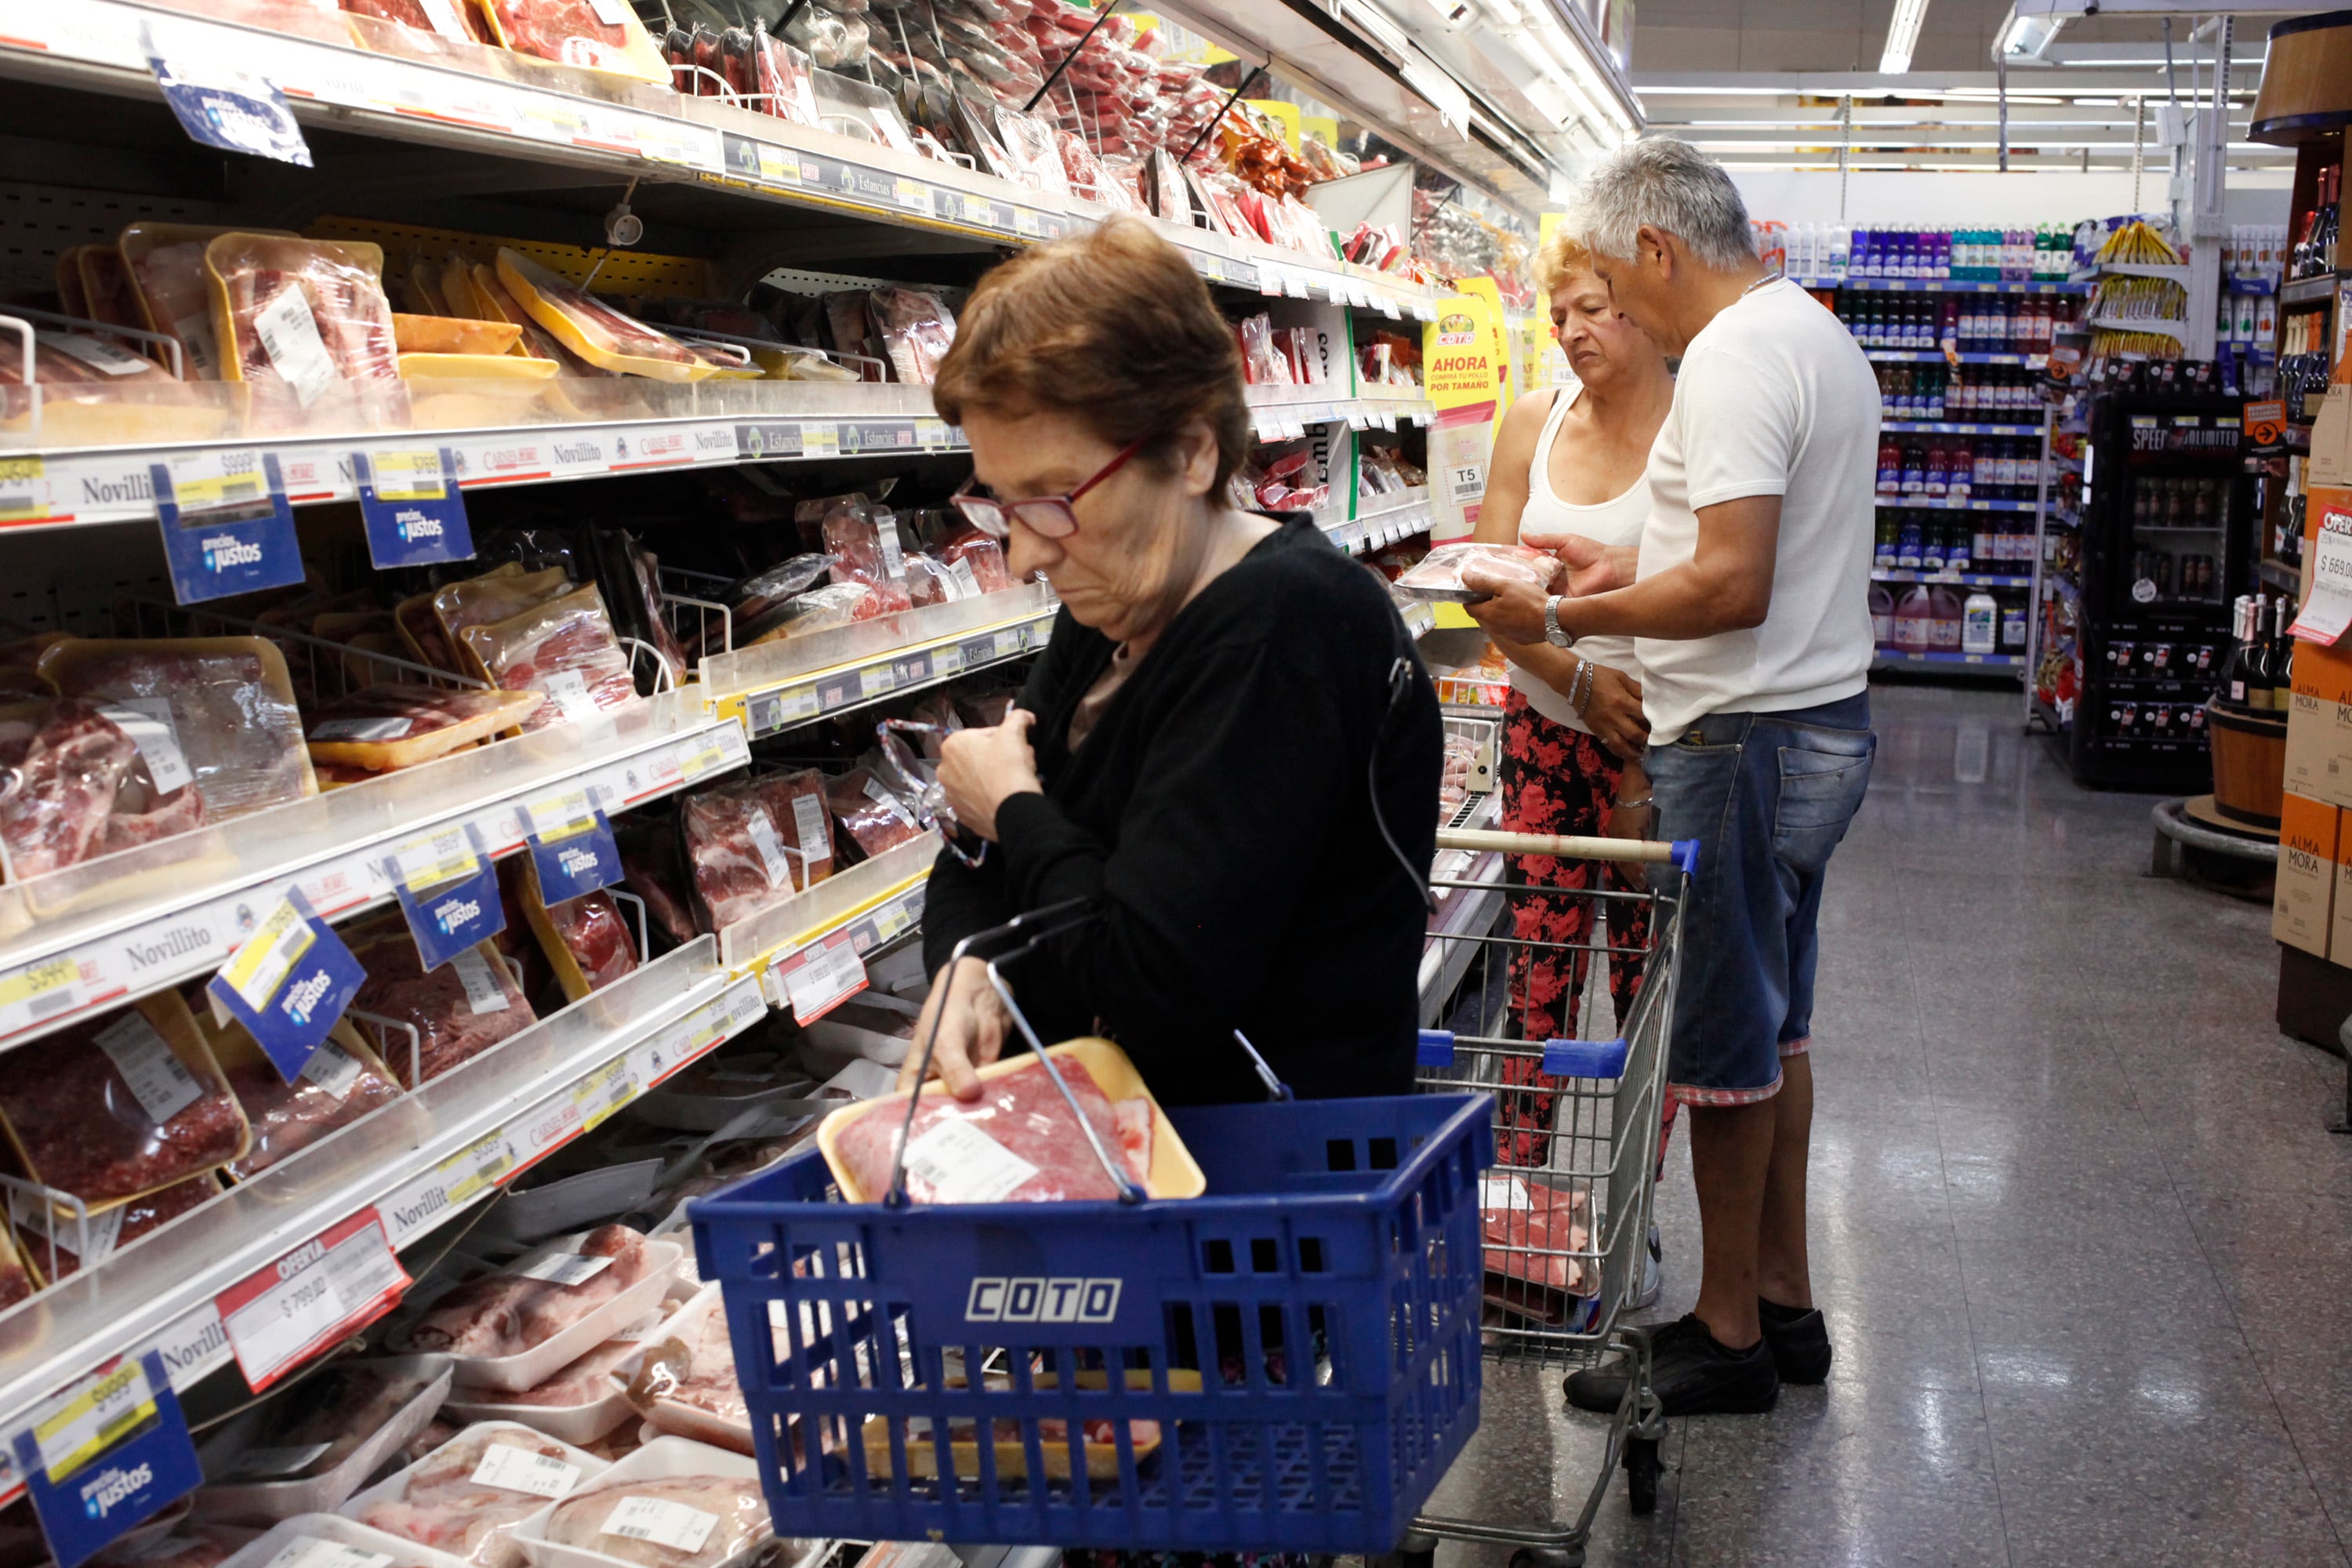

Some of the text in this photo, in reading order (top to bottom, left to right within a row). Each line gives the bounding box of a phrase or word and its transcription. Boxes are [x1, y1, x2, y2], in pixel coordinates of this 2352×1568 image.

[858, 174, 890, 196] Estancias
[1437, 332, 1475, 345] COTO
[1432, 357, 1487, 372] AHORA
[1431, 379, 1489, 391] POR TAMAÑO
[695, 428, 733, 450] Novillito
[865, 430, 895, 447] Estancias
[553, 441, 601, 464] Novillito
[1457, 469, 1475, 482] T5
[407, 516, 443, 543] justos
[215, 542, 263, 573] justos
[2321, 554, 2327, 572] $
[2295, 695, 2319, 711] MORA
[2296, 684, 2320, 699] ALMA
[2289, 833, 2320, 857] ALMA
[568, 851, 598, 878] justos
[2288, 849, 2319, 873] MORA
[445, 900, 481, 935] justos
[125, 927, 212, 972] Novillito
[295, 969, 332, 1023] justos
[277, 1238, 327, 1281] OFERTA
[964, 1277, 1123, 1323] COTO
[96, 1461, 153, 1518] justos
